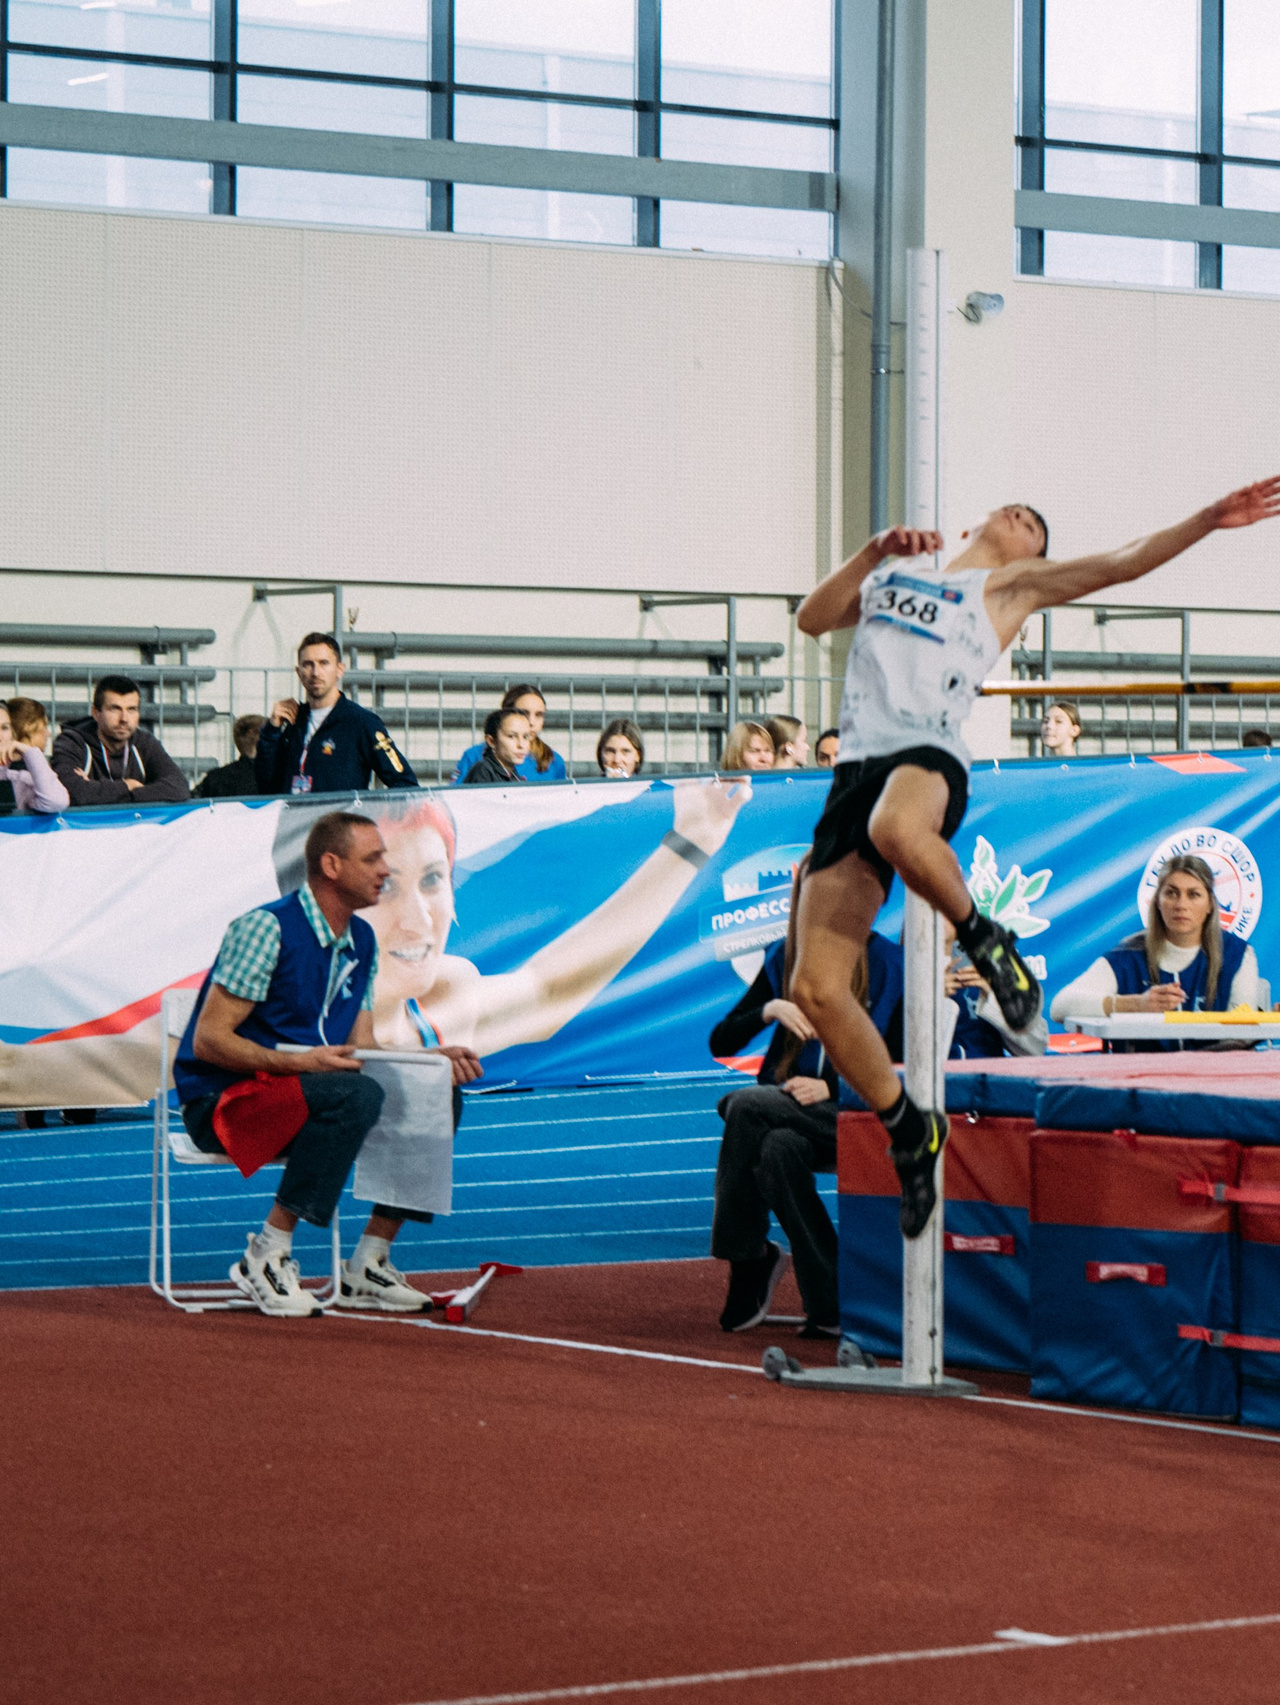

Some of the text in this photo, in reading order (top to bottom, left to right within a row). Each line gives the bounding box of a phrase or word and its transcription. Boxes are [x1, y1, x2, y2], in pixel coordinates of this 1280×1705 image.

[877, 590, 937, 624] 368
[1196, 834, 1217, 848] ВО
[1221, 840, 1256, 882] СШОР
[711, 897, 791, 931] ПРОФЕСС
